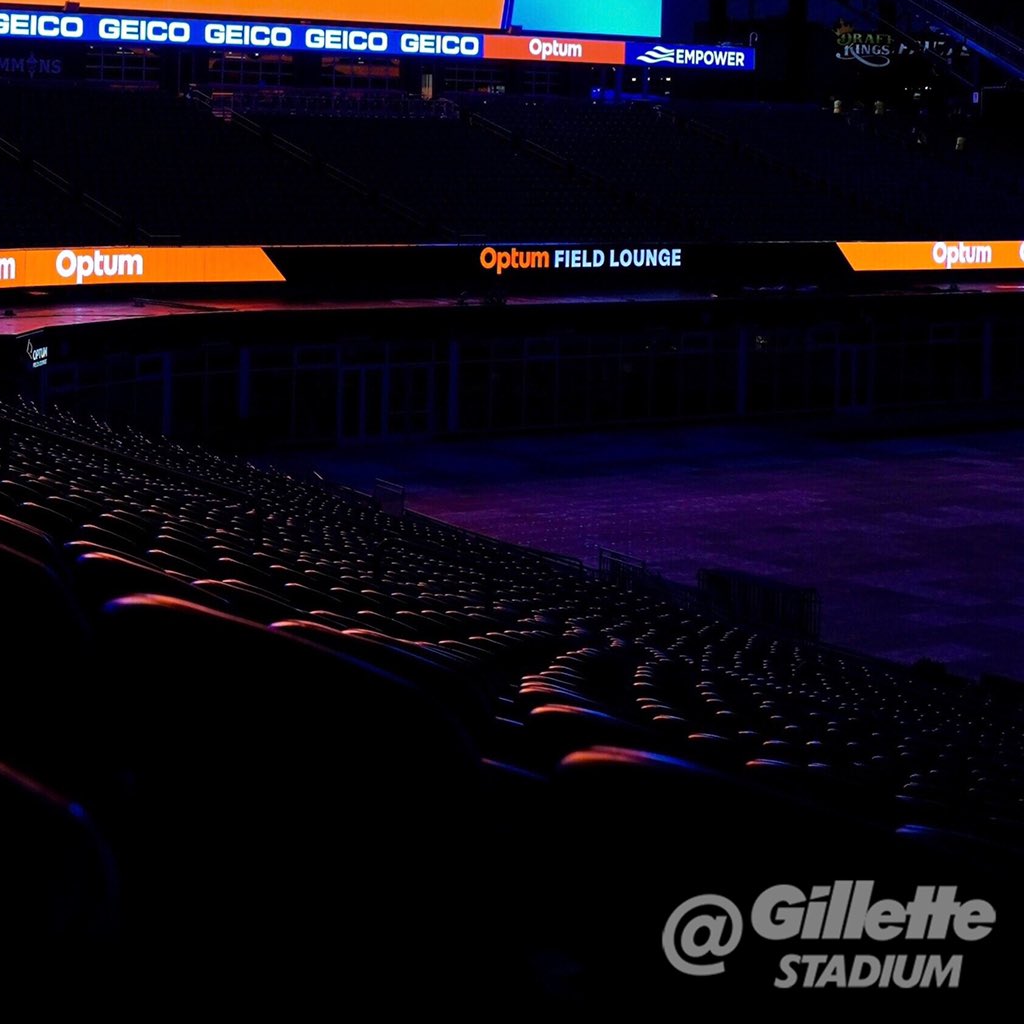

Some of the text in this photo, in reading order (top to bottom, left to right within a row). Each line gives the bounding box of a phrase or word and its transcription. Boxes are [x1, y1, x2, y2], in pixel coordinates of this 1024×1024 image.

[98, 18, 191, 42] GEICO
[204, 24, 292, 47] GEICO
[305, 29, 388, 52] GEICO
[400, 33, 479, 55] GEICO
[837, 32, 894, 46] DRAFT
[528, 38, 582, 61] Optum
[675, 49, 745, 68] EMPOWER
[839, 43, 890, 62] KINGS
[56, 249, 144, 284] Optum
[479, 246, 682, 275] Optum FIELD LOUNGE
[932, 241, 992, 269] Optum
